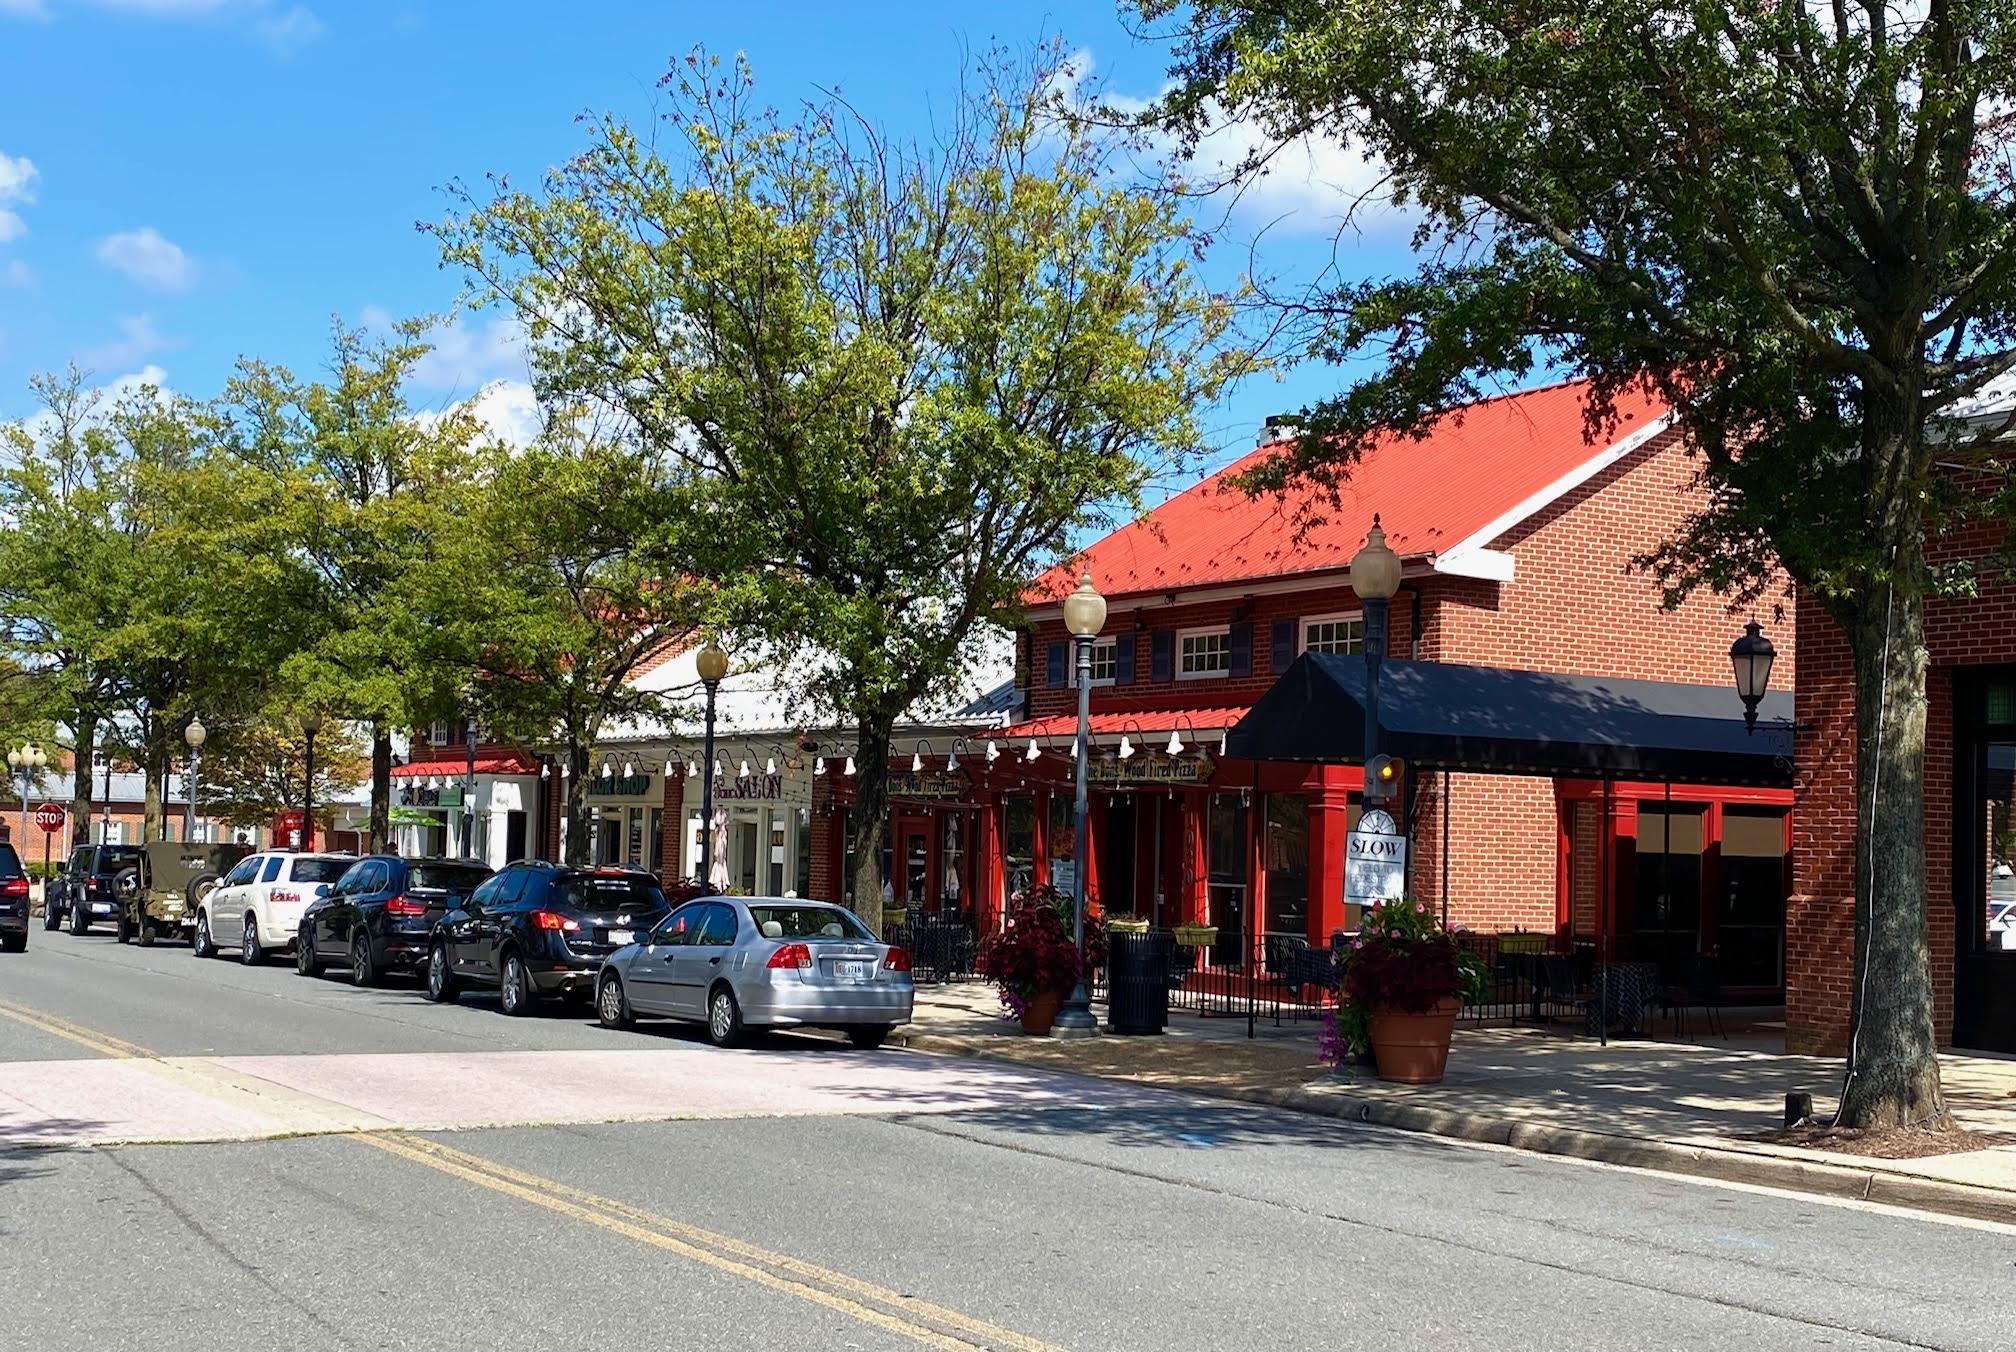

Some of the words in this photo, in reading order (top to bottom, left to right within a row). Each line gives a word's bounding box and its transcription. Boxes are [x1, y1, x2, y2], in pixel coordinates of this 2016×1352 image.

[1124, 760, 1146, 777] Wood
[1174, 759, 1196, 777] Pizza
[616, 775, 650, 795] SHOP
[36, 811, 64, 825] STOP
[1350, 839, 1403, 857] SLOW
